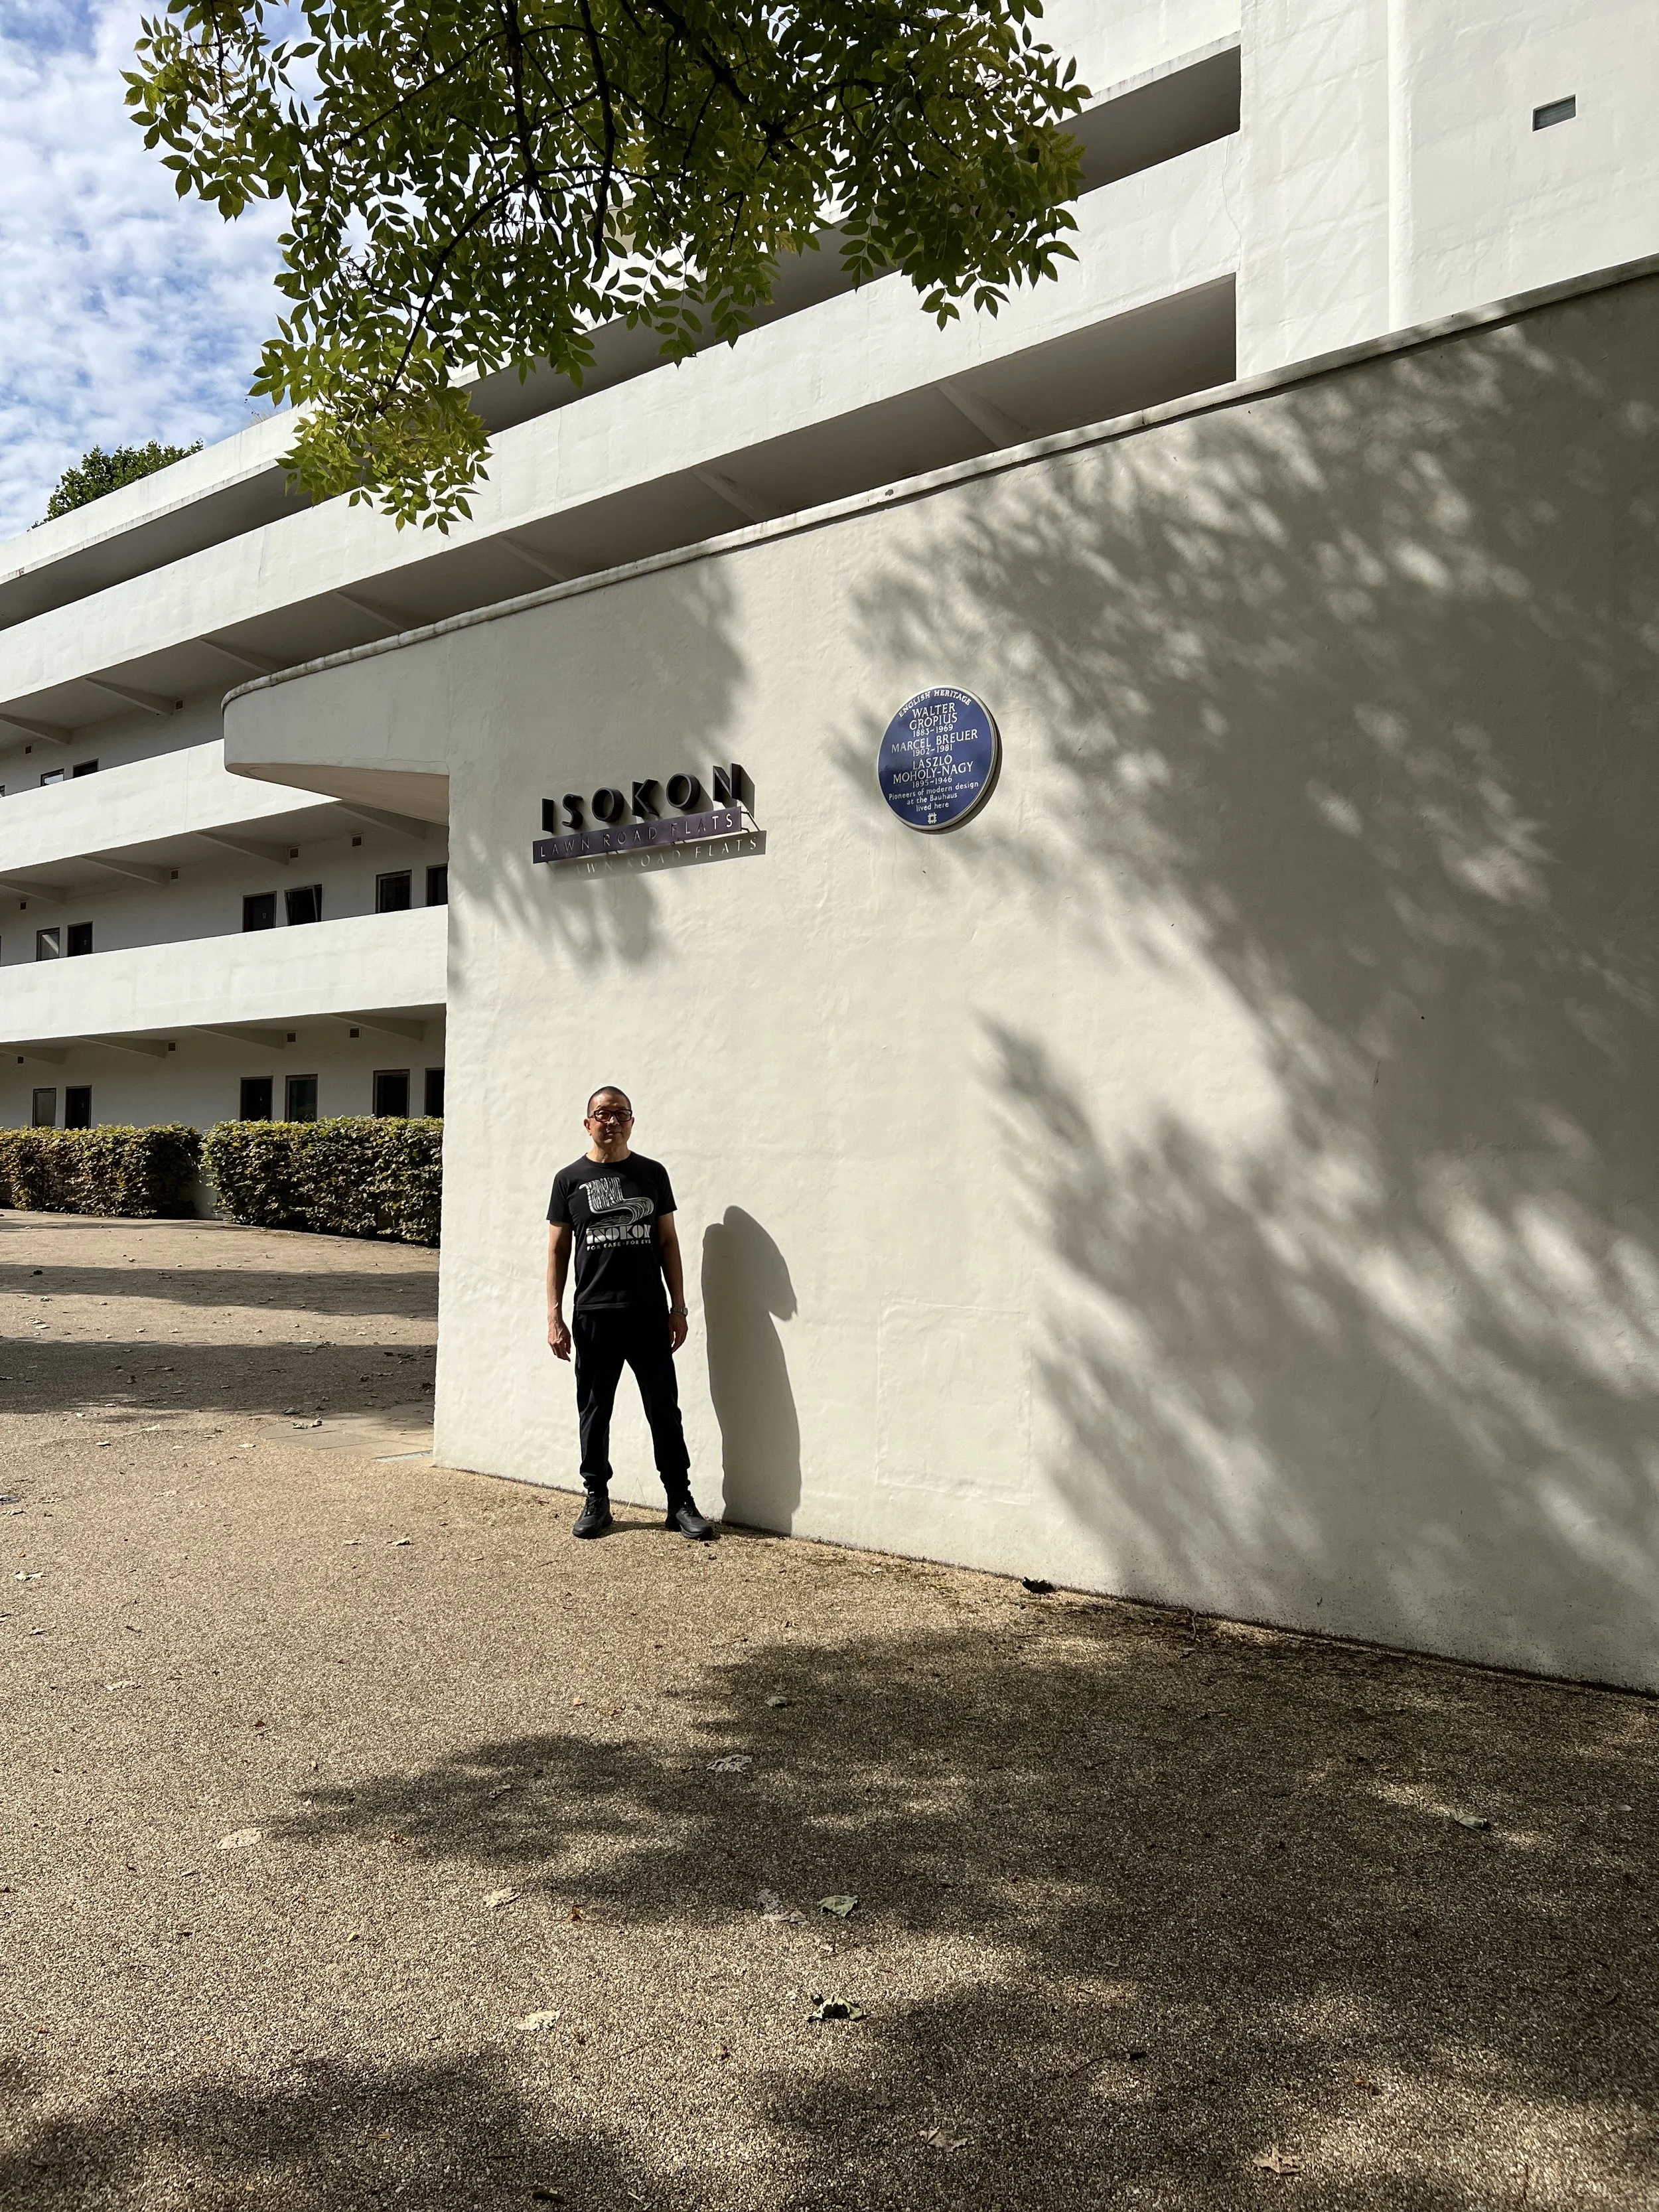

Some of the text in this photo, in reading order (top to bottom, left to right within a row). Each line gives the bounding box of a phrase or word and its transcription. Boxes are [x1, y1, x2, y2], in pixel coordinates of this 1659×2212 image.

[899, 689, 972, 717] ENGLISH HERITAGE
[912, 702, 956, 719] WALTER
[909, 712, 958, 730] GROPIUS
[891, 729, 978, 753] MARCEL BREUER
[893, 761, 974, 784] MOHOLY-NAGY
[541, 763, 742, 834] ISOKON
[889, 791, 916, 800] Pioneers
[926, 785, 952, 794] modern
[955, 782, 979, 790] design
[930, 792, 958, 802] Bauhaus
[916, 803, 932, 812] lived
[540, 813, 733, 857] LAWN ROAD FLATS
[586, 1224, 651, 1244] ISOKON
